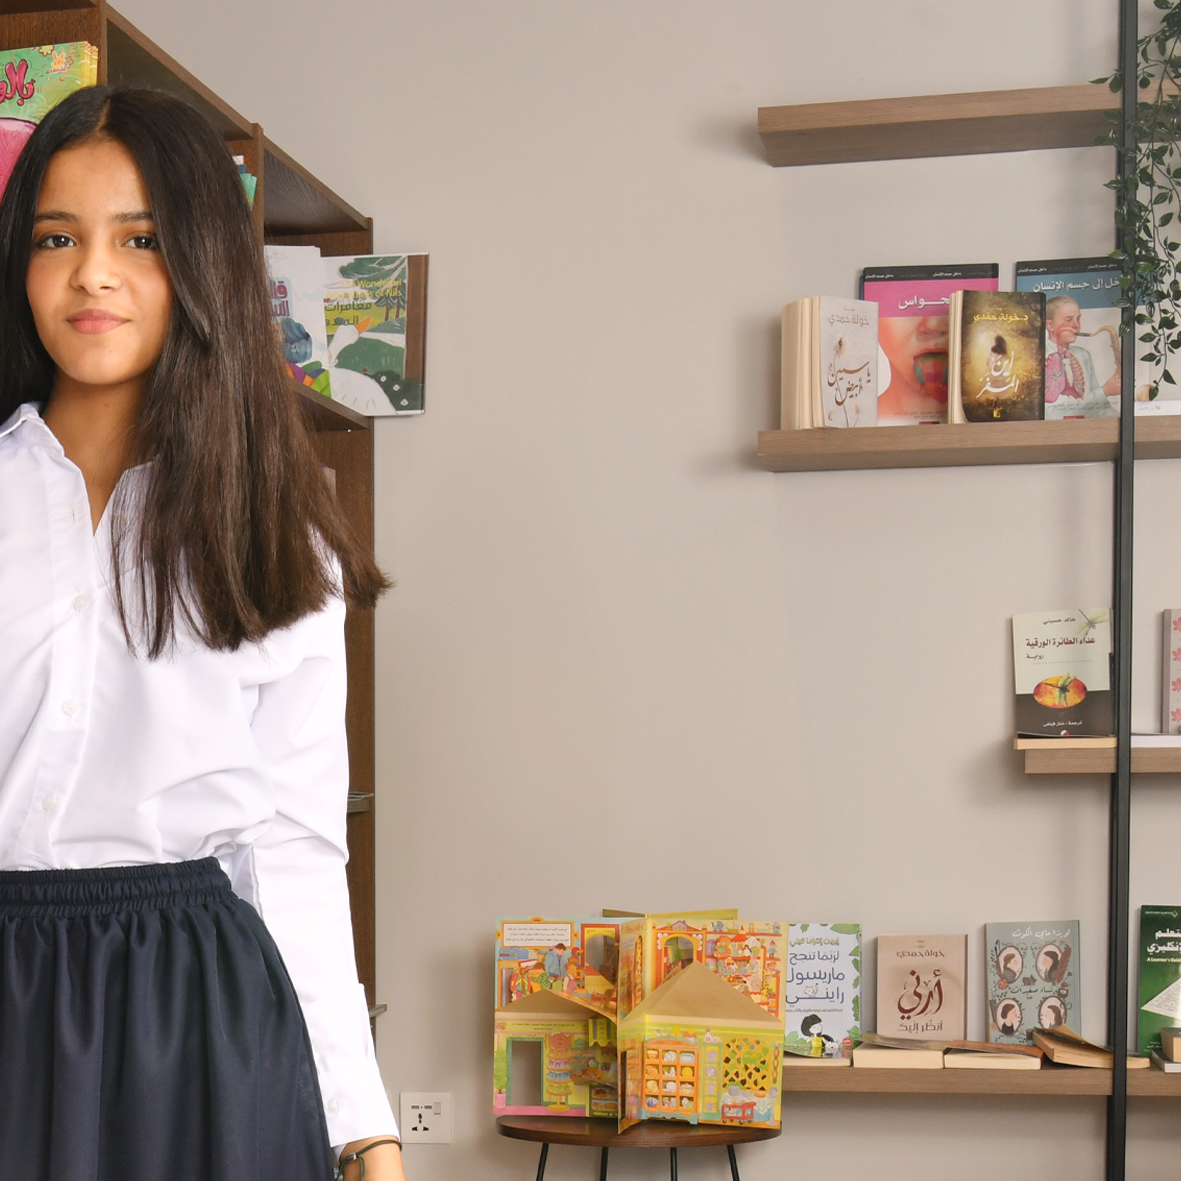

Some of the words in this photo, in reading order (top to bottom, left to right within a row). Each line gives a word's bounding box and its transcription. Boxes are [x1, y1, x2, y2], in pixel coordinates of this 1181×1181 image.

[1066, 280, 1090, 290] جسم
[386, 288, 402, 297] Nils
[898, 295, 950, 310] حواس
